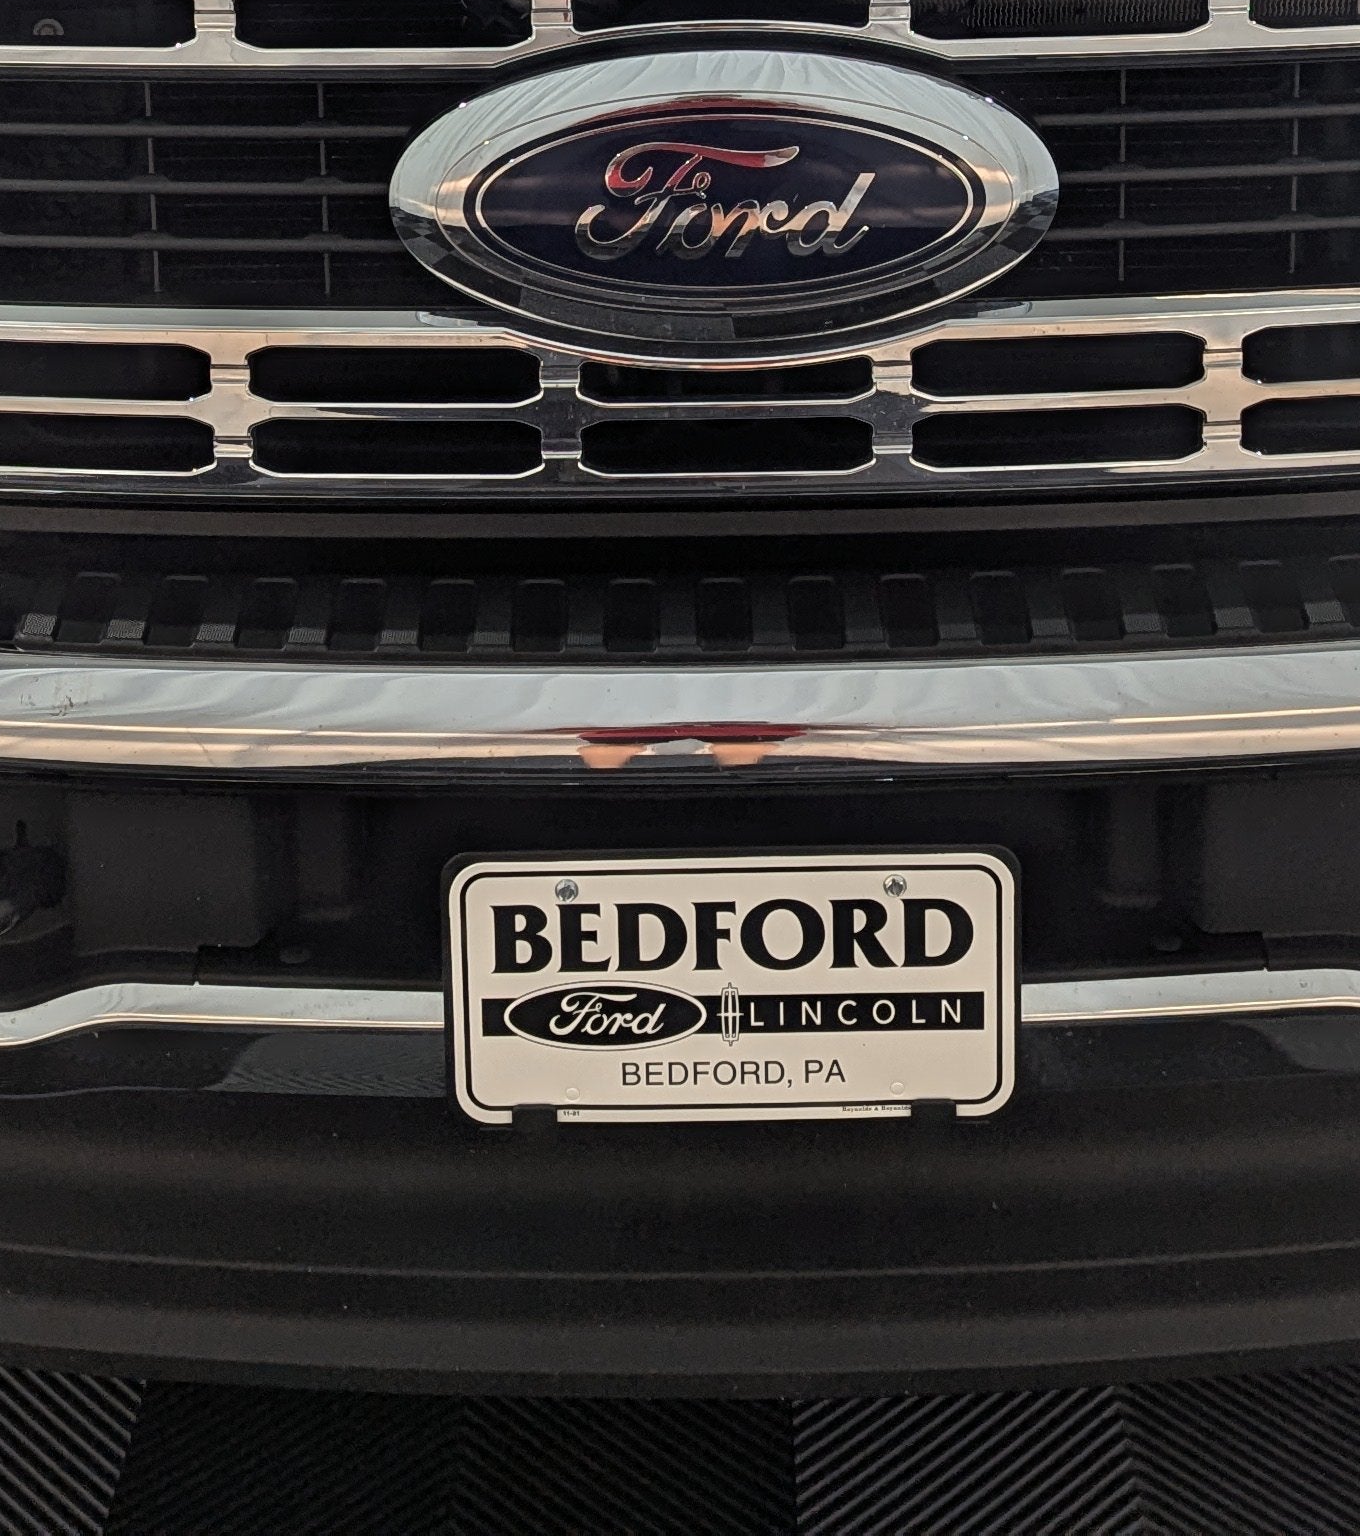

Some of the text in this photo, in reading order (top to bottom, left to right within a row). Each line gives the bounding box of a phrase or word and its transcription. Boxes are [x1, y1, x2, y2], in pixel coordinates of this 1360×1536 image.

[575, 140, 876, 260] Ford
[490, 897, 975, 974] BEDFORD
[548, 991, 962, 1036] Ford LINCOLN
[621, 1059, 846, 1089] BEDFORD, PA
